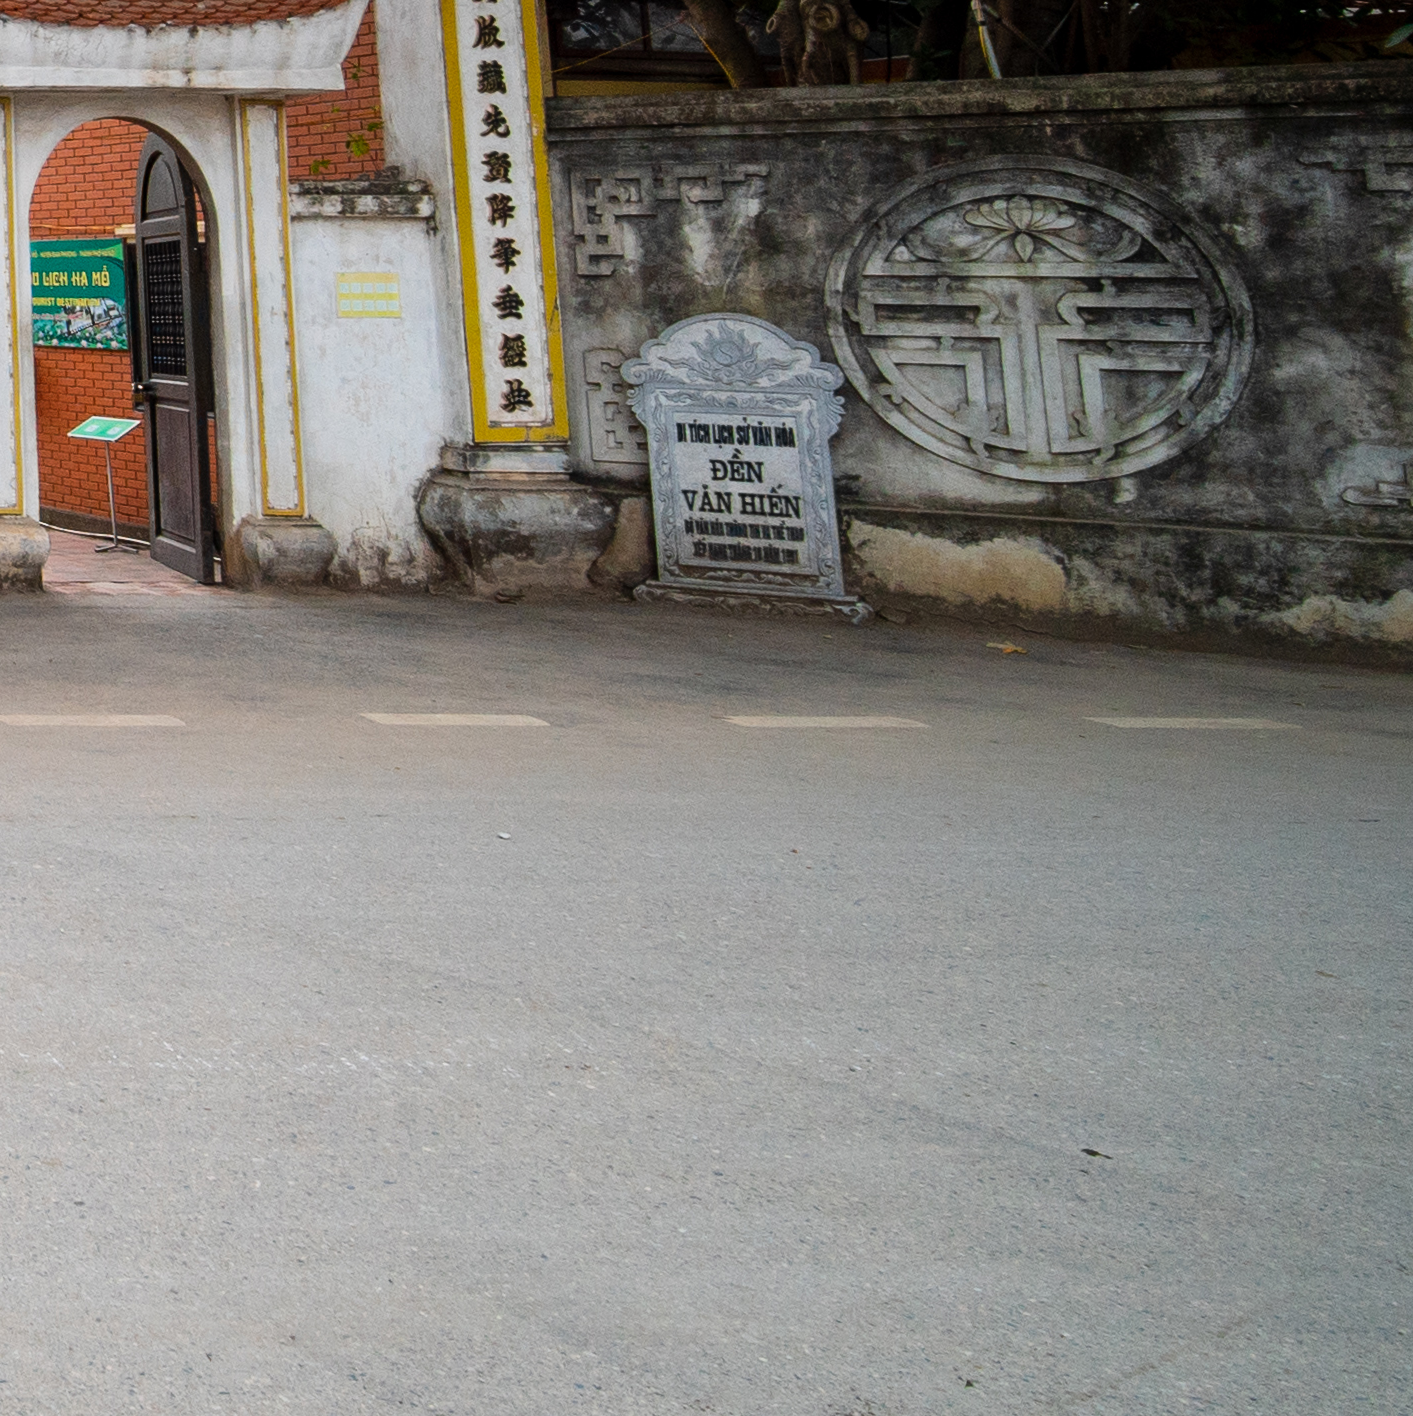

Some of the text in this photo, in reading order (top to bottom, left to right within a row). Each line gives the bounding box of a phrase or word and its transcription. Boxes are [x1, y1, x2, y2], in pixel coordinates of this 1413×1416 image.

[676, 422, 687, 443] DI
[688, 418, 711, 444] TÍCH
[712, 423, 735, 449] LỊCH
[735, 416, 751, 446] SỬ
[751, 420, 773, 447] VĂN
[709, 447, 764, 483] ĐỀN
[738, 483, 801, 519] HIẾN
